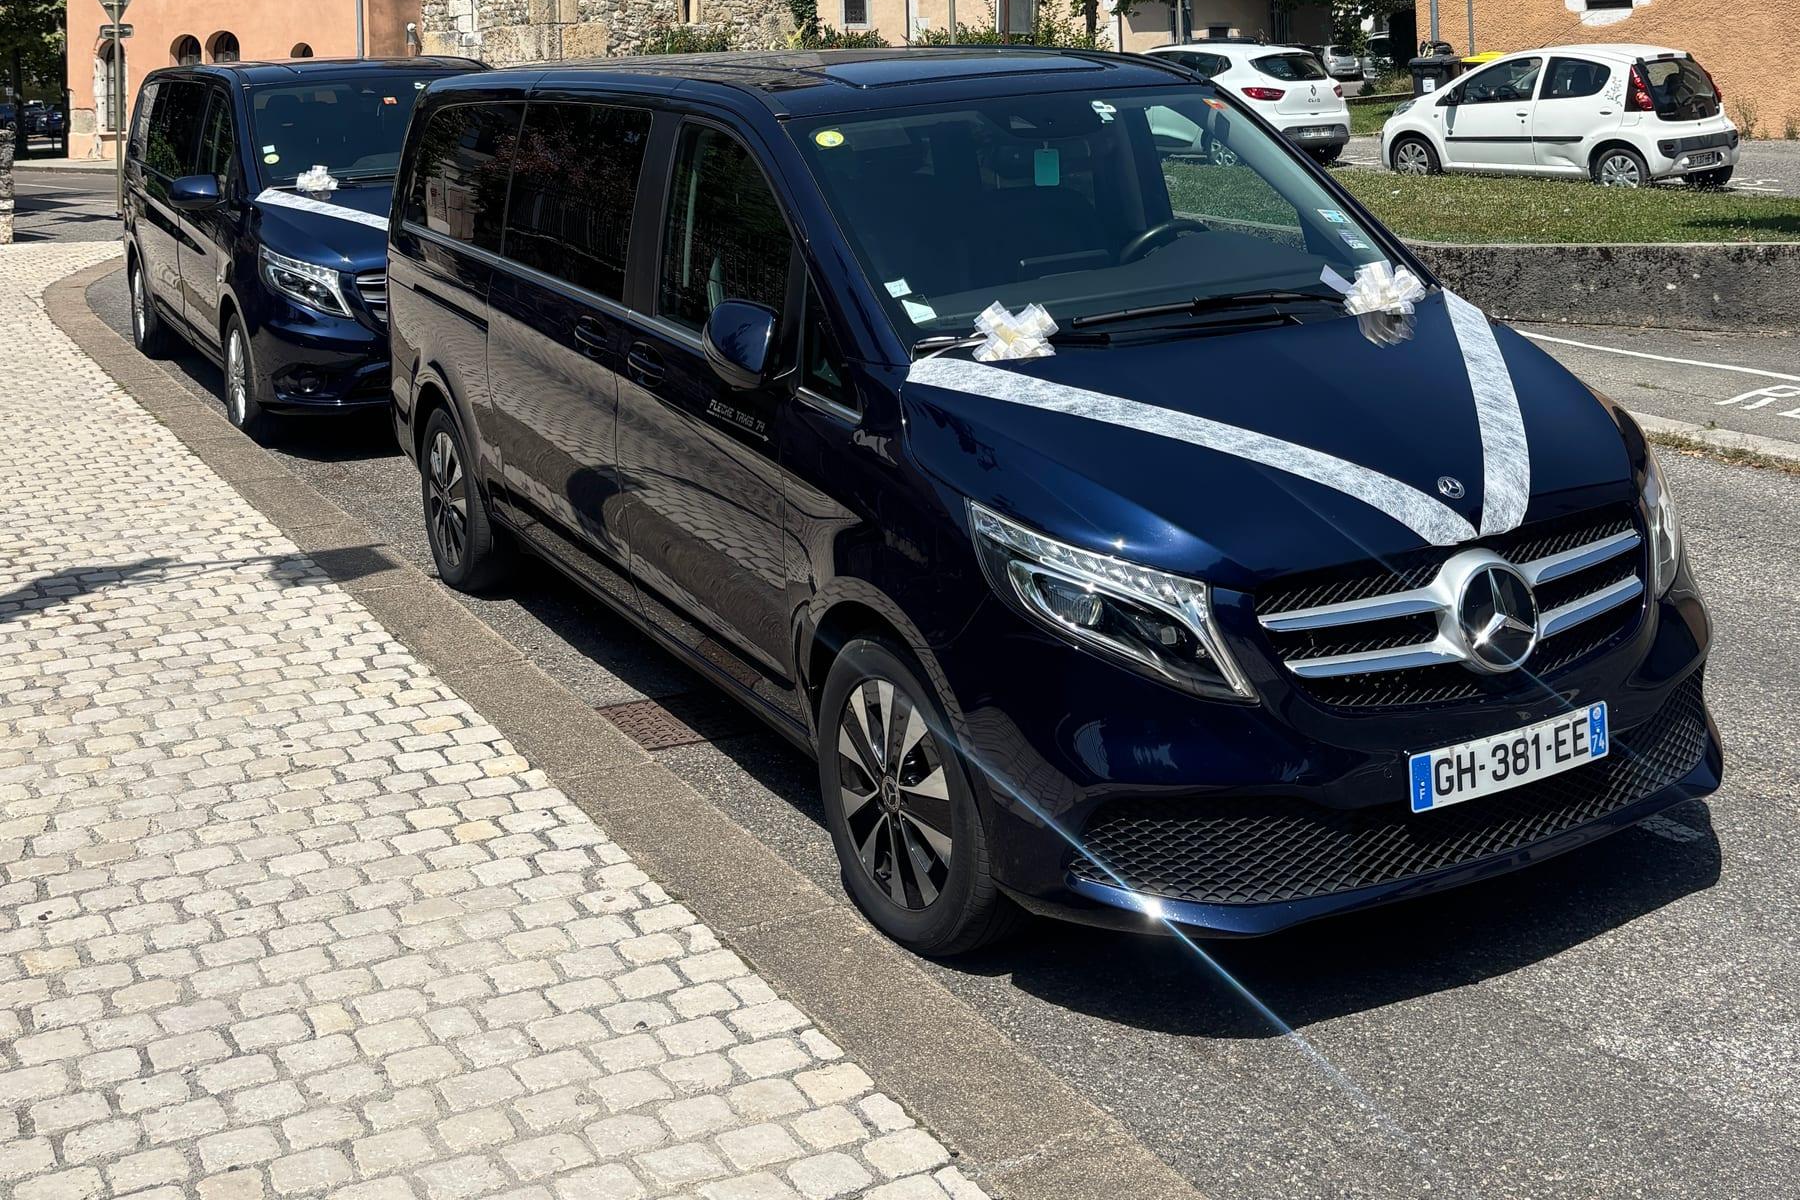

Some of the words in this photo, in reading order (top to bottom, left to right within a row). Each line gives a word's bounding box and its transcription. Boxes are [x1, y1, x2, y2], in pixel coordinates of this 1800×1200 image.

[1418, 788, 1426, 800] F
[1434, 717, 1589, 797] GH-381-EE
[1591, 732, 1605, 753] 74
